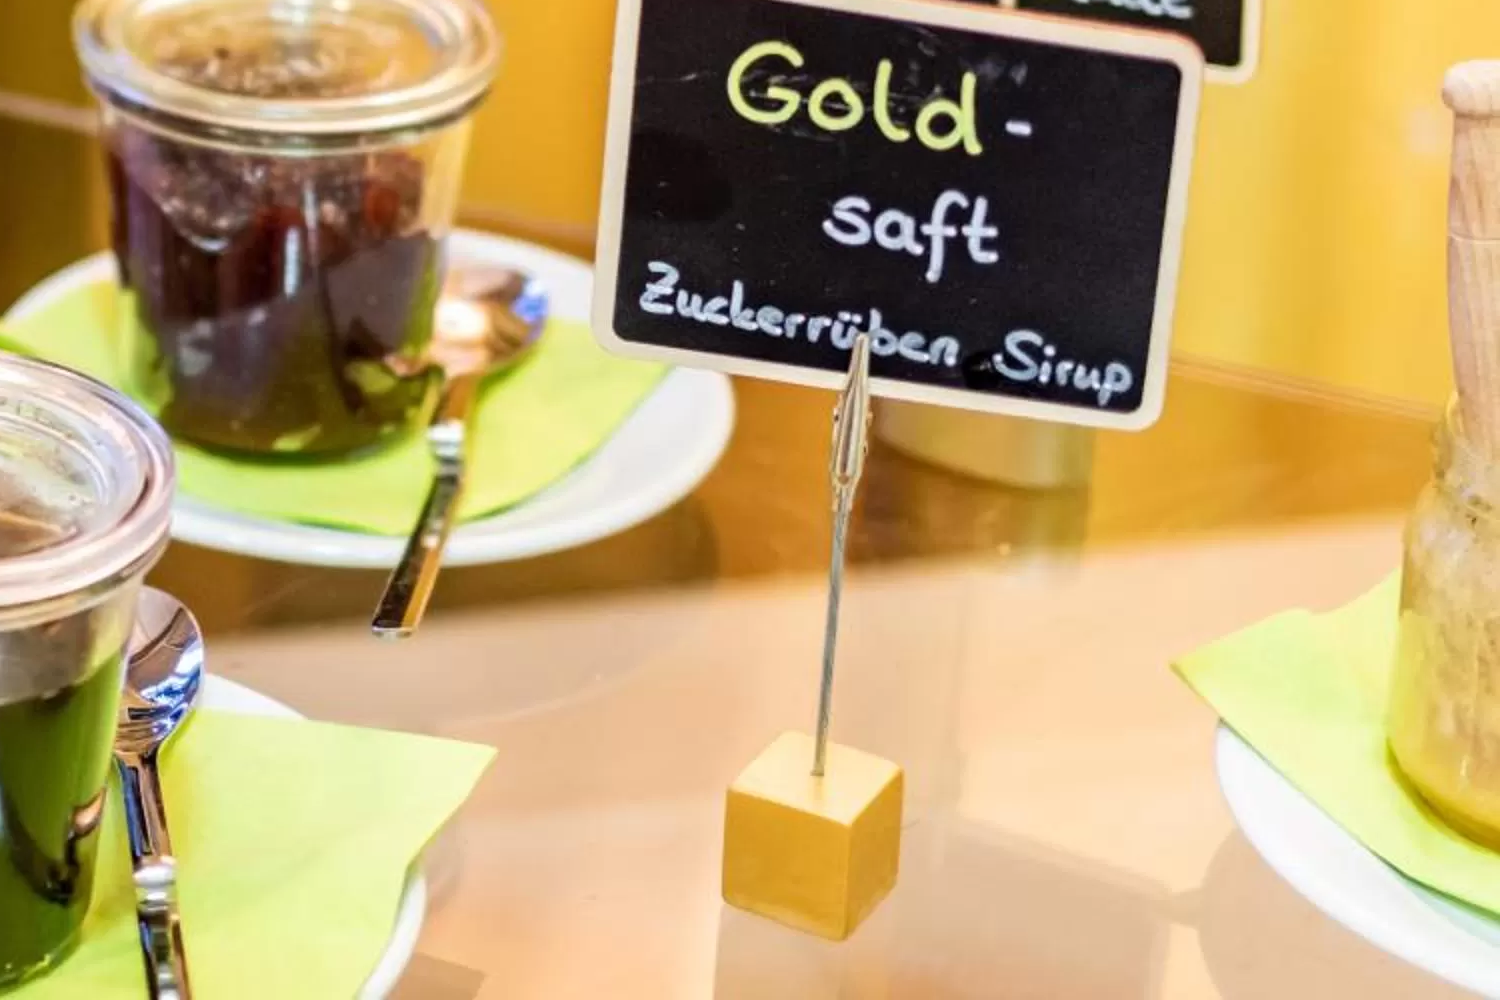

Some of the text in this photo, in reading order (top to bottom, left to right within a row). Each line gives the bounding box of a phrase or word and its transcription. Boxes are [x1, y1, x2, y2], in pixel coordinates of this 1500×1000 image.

[823, 190, 998, 283] saft
[640, 261, 1133, 406] Zuckerrüben Sirup
